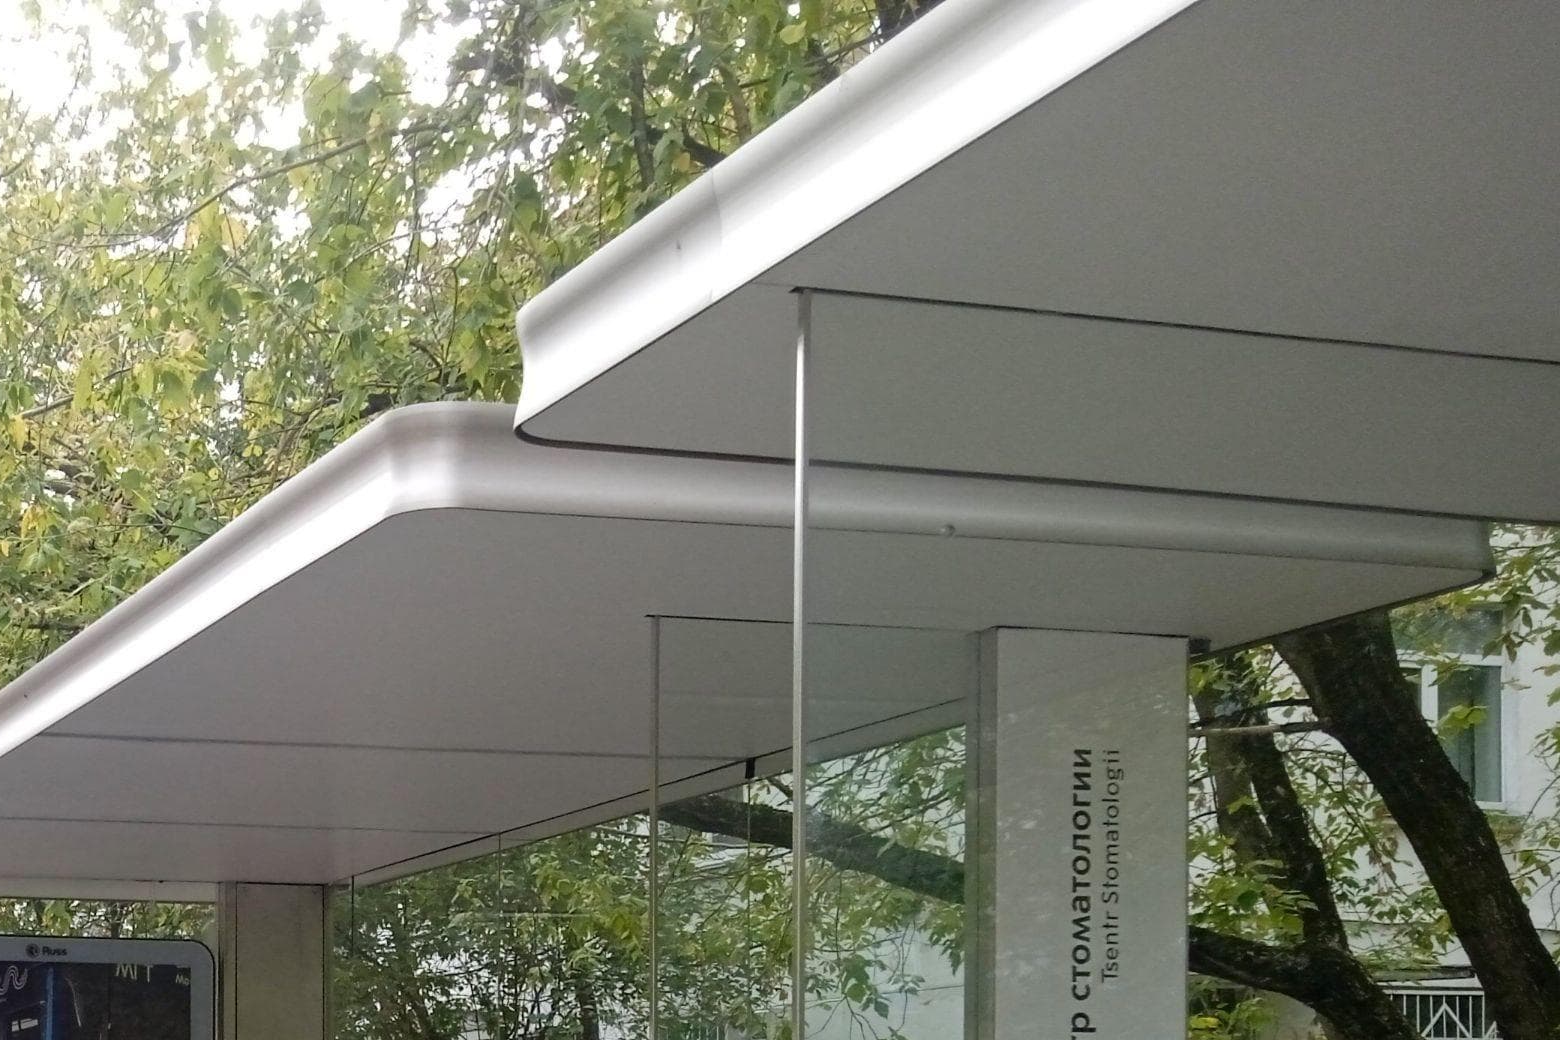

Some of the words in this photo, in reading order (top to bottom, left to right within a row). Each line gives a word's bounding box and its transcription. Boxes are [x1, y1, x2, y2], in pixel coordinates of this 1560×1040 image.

[1070, 748, 1093, 1002] стоматологии
[1100, 749, 1126, 906] Stomatologii
[1100, 911, 1119, 984] Tsentr
